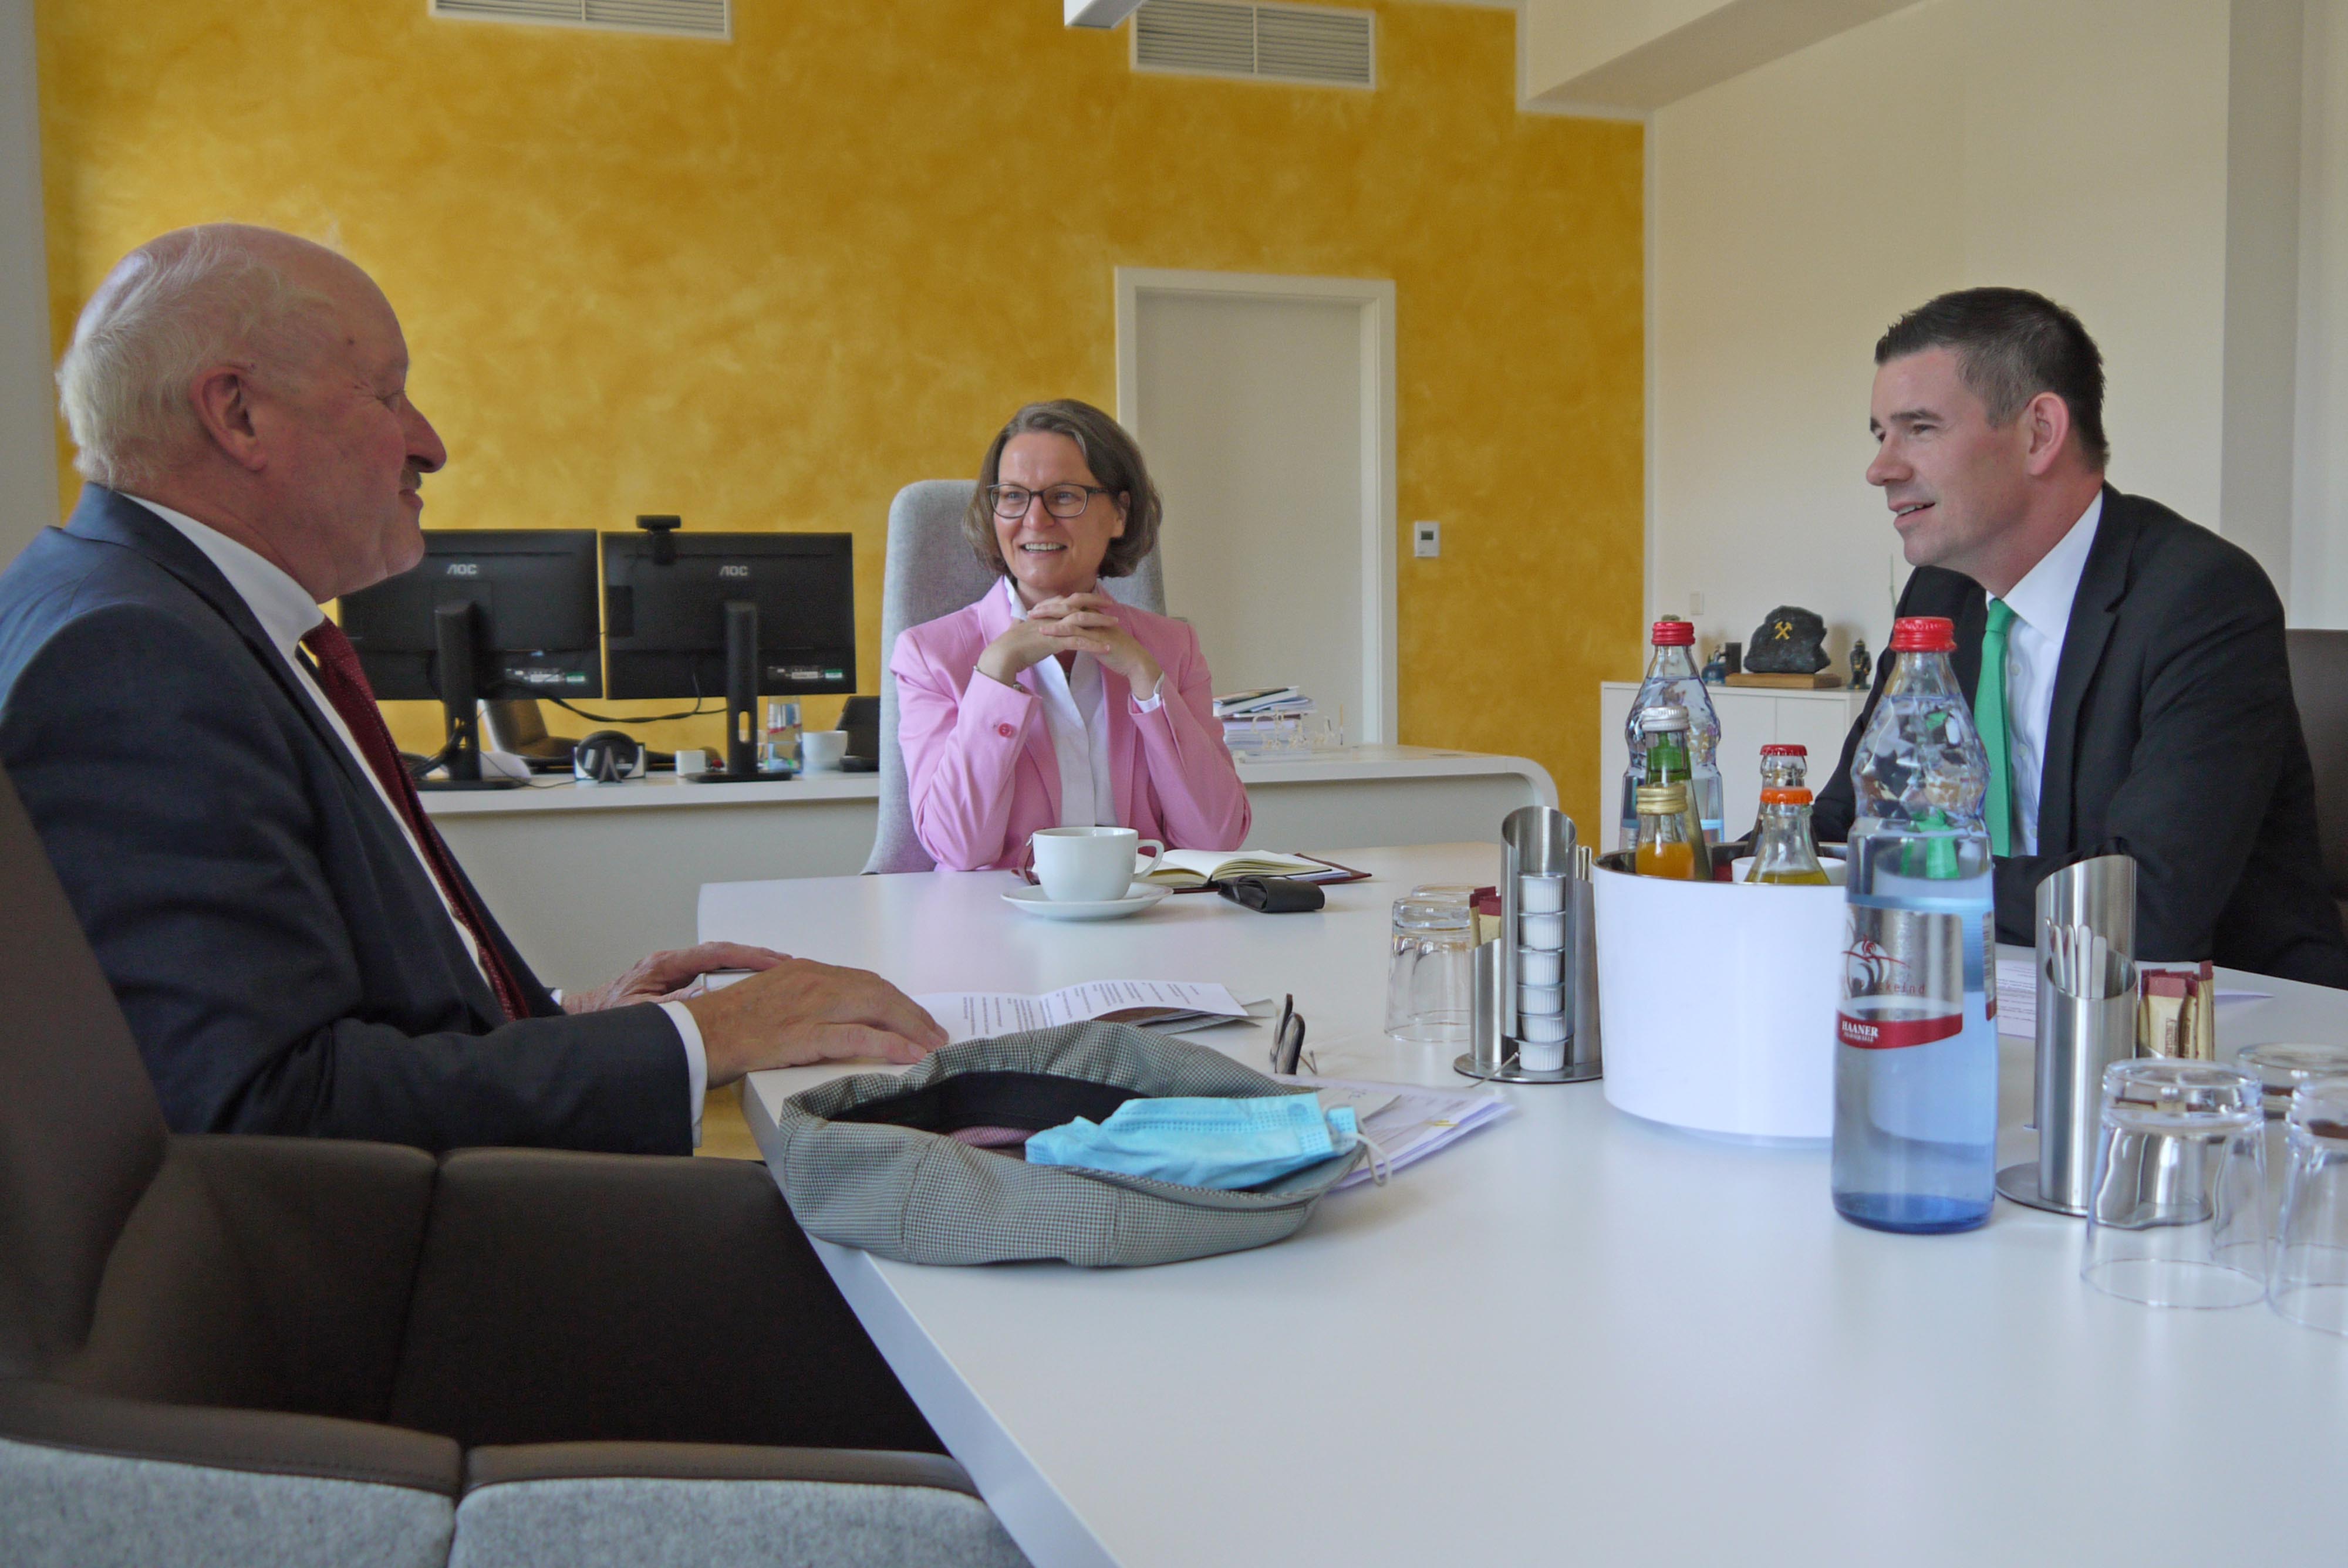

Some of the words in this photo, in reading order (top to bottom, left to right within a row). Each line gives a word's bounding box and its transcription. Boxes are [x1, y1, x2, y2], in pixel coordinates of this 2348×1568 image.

[447, 563, 478, 575] AOC
[719, 565, 748, 576] AOC
[1842, 1020, 1879, 1038] HAANER
